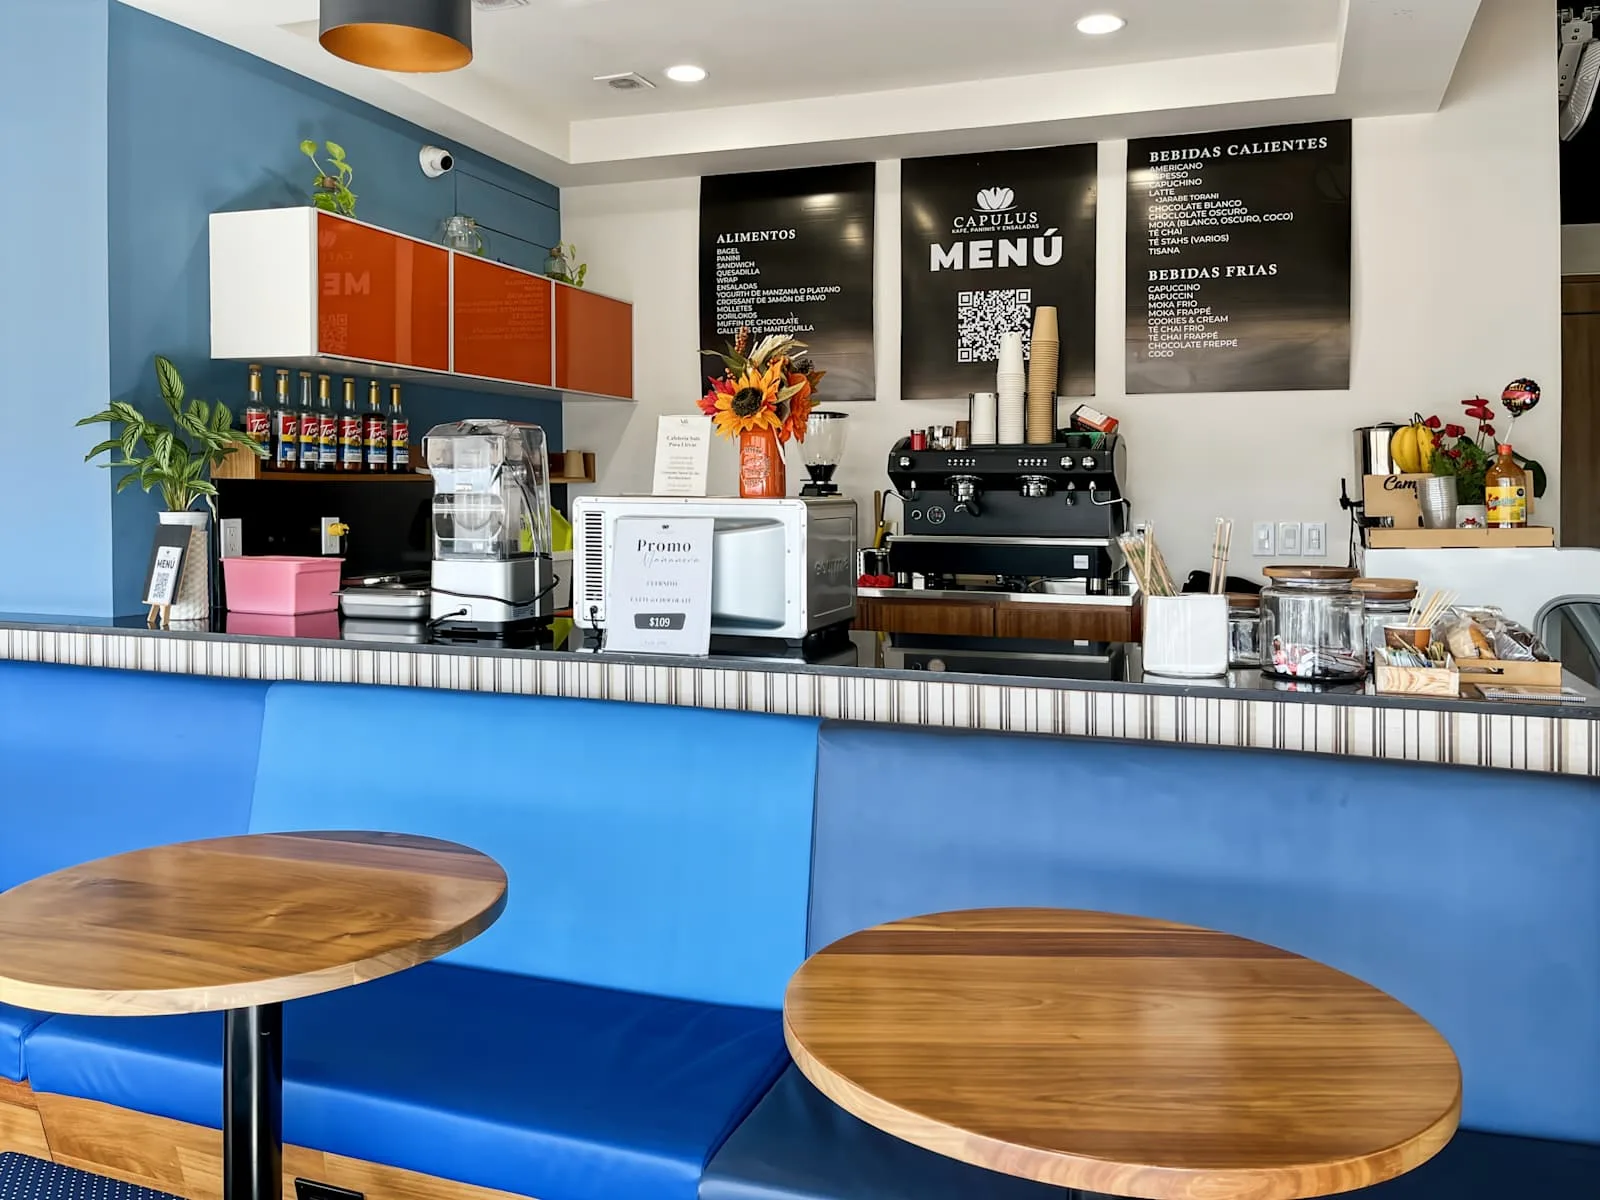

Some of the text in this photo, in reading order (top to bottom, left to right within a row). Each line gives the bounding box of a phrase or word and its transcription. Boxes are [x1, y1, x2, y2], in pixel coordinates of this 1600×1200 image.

[1150, 136, 1328, 162] BEBIDAS CALIENTES
[1150, 162, 1203, 173] AMERICANO
[1149, 178, 1202, 188] CAPUCHINO
[1149, 188, 1175, 196] LATTE
[1190, 192, 1219, 201] TORANI
[1149, 200, 1242, 213] CHOCOLATE BLANCO
[953, 211, 1038, 228] CAPULUS
[1149, 208, 1248, 221] CHOCLOLATE OSCURO
[1149, 212, 1294, 229] MOKA (BLANCO, OSCURO, COCO)
[716, 229, 796, 244] ALIMENTOS
[1161, 236, 1189, 246] STAHS
[1191, 234, 1229, 244] (VARIOS)
[930, 228, 1063, 272] MENÚ
[1149, 247, 1180, 256] TISANA
[716, 268, 760, 277] QUESADILLA
[1148, 264, 1278, 281] BEBIDAS FRIAS
[762, 288, 798, 296] MANZANA
[807, 286, 841, 294] PLATANO
[1148, 283, 1200, 293] CAPUCCINO
[1148, 292, 1193, 301] RAPUCCIN
[716, 298, 755, 306] CROISSANT
[1148, 300, 1198, 309] MOKA FRIO
[717, 312, 758, 320] DORILOKOS
[1148, 307, 1211, 317] MOKA FRAPPÉ
[1148, 317, 1187, 326] COOKIES
[1197, 315, 1228, 324] CREAM
[764, 324, 814, 333] MANTEQUILLA
[1160, 325, 1182, 333] CHAI
[1184, 324, 1205, 332] FRIO
[1184, 332, 1218, 341] FRAPPÉ
[1148, 341, 1201, 350] CHOCOLATE
[637, 539, 692, 552] Promo
[649, 617, 670, 628] $109
